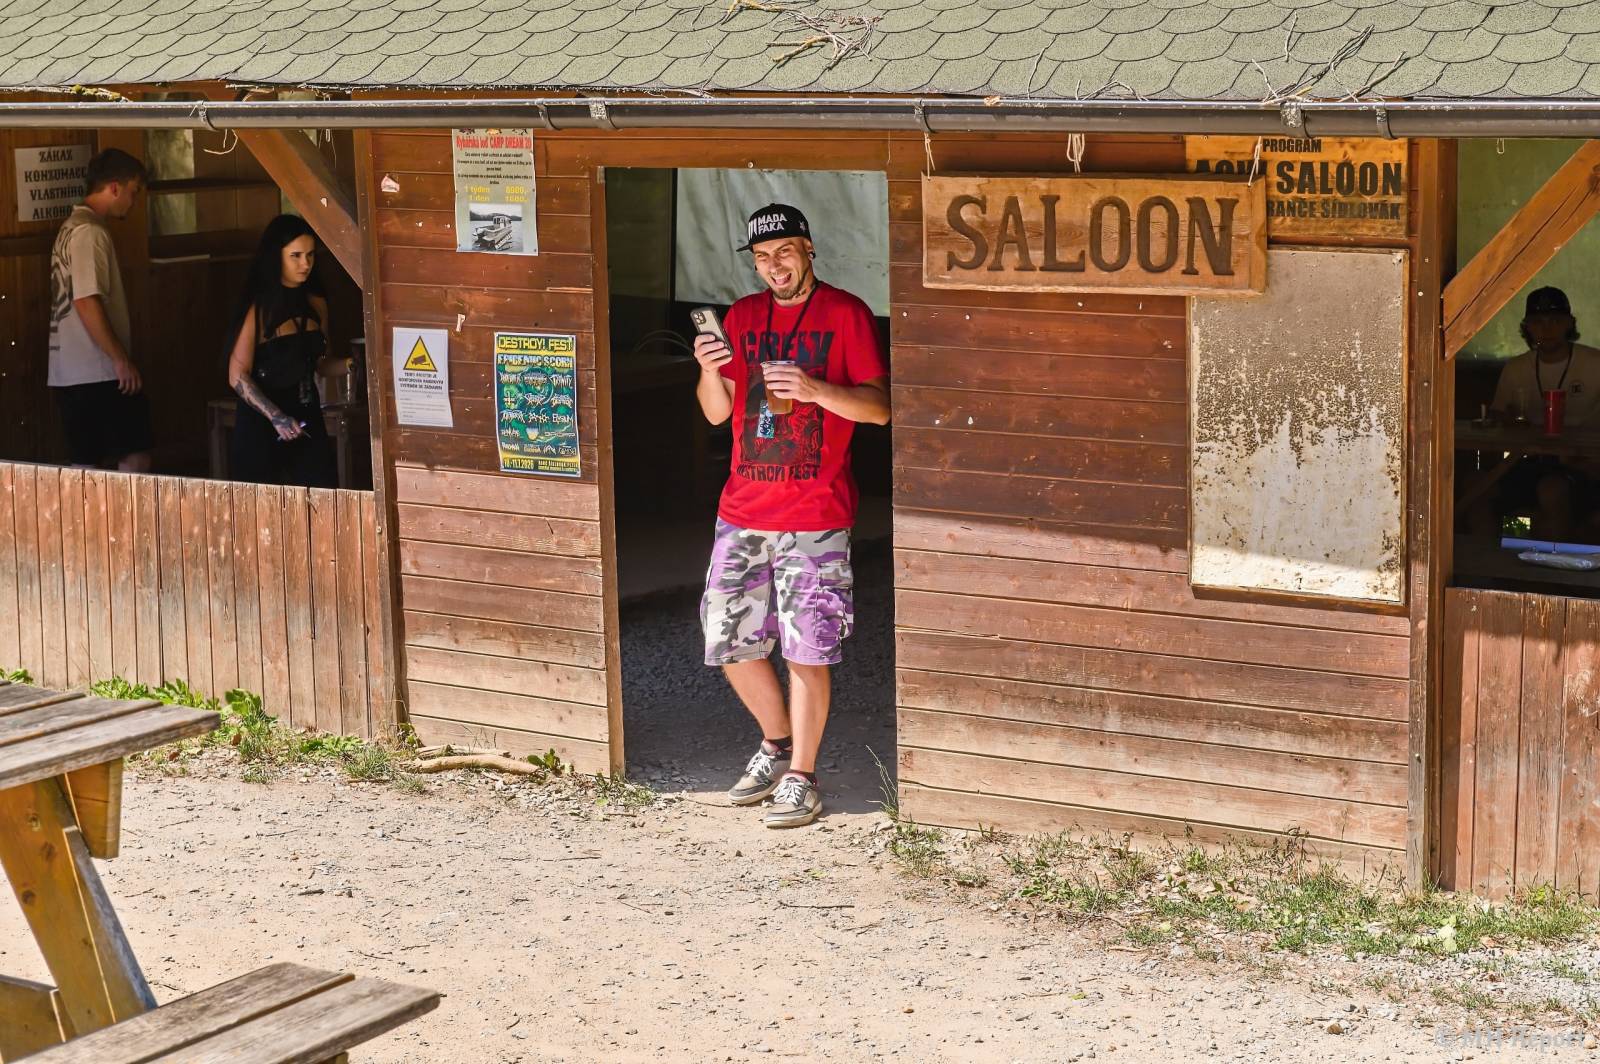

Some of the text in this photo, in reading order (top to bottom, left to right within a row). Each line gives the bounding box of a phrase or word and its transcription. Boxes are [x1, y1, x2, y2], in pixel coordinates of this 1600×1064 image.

[1262, 138, 1321, 152] PROGRAM
[39, 148, 73, 163] ZÁKAZ
[1276, 160, 1402, 196] SALOON
[30, 185, 84, 201] VLASTNÍHO
[32, 205, 72, 220] ALKOHO
[758, 213, 787, 226] MADA
[758, 222, 785, 235] FAKA
[946, 194, 1240, 276] SALOON
[548, 338, 573, 352] FEST
